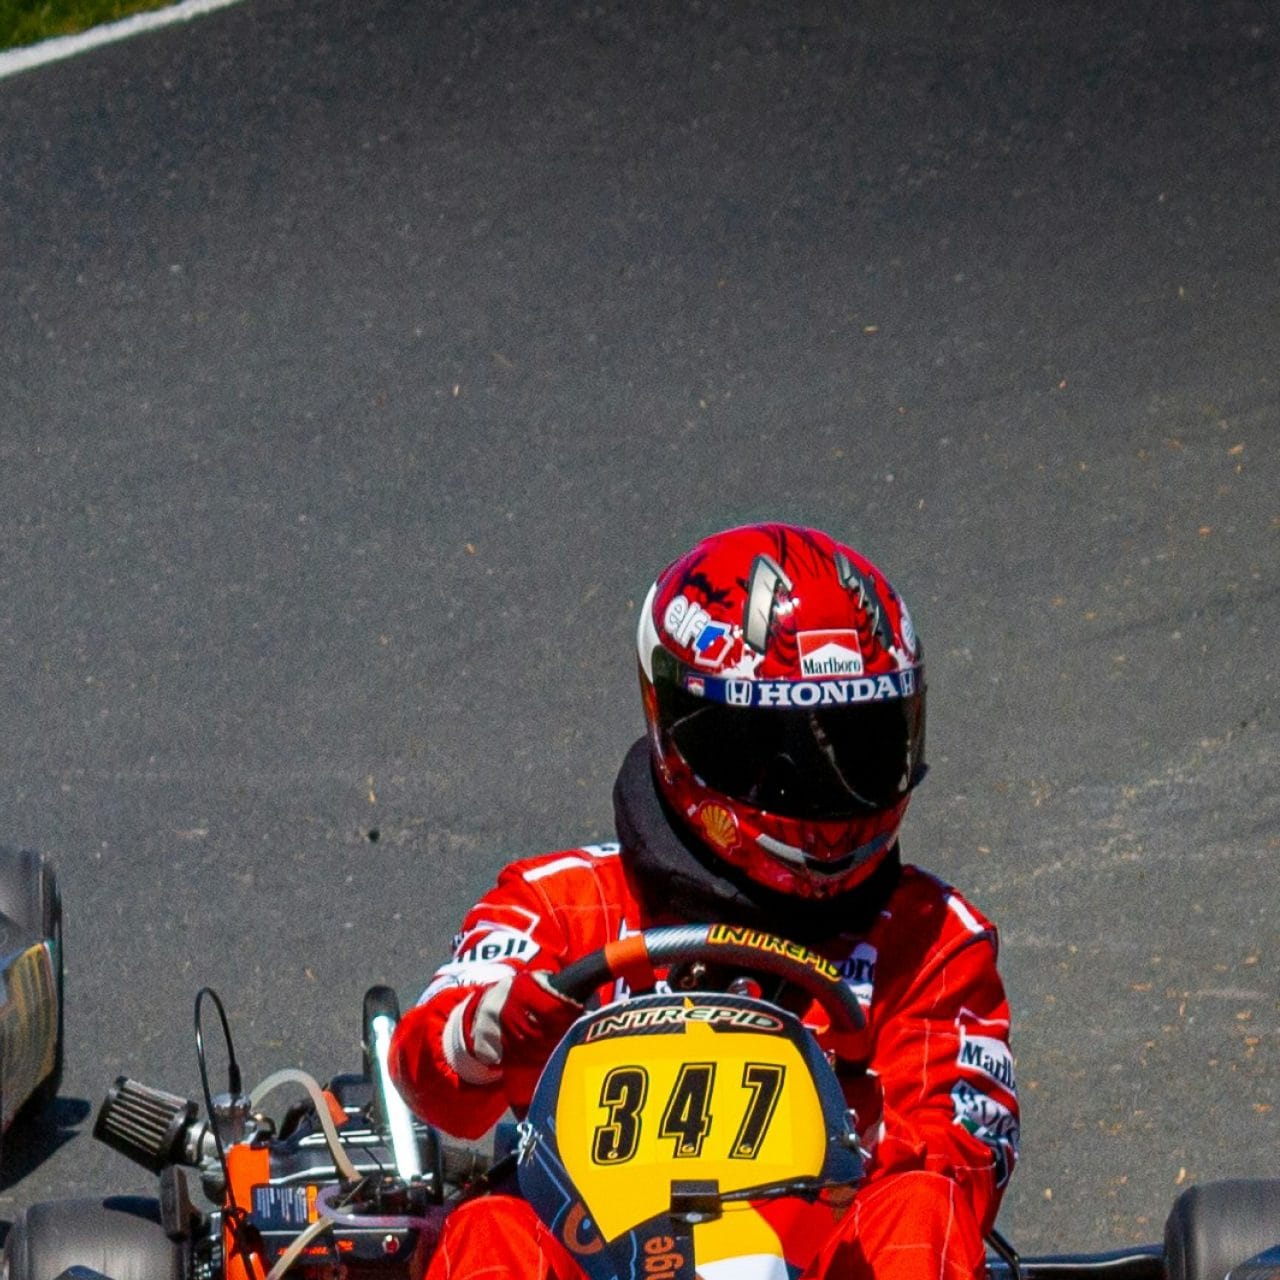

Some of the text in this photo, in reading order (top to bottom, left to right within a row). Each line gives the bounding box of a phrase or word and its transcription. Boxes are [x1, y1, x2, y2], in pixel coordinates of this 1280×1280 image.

[664, 594, 711, 649] elf
[802, 656, 861, 675] Marlboro
[758, 674, 898, 706] HONDA
[706, 923, 844, 983] INTREPID
[586, 1005, 784, 1042] INTREPID
[591, 1062, 787, 1166] 347
